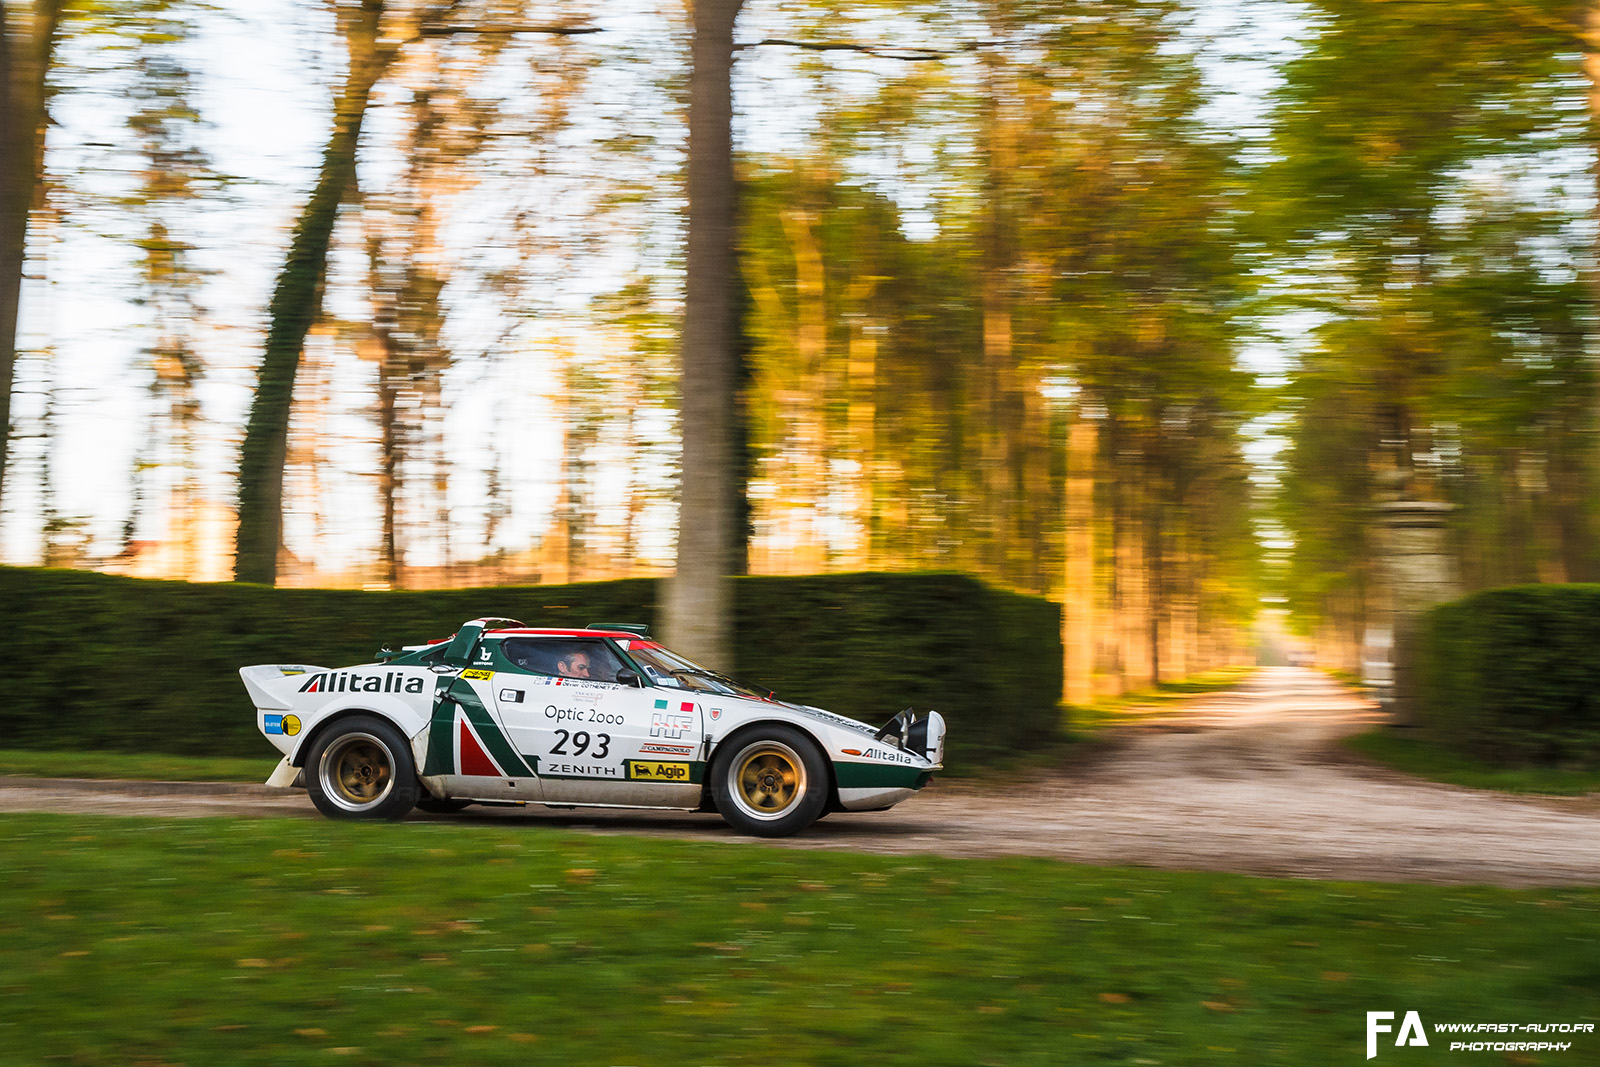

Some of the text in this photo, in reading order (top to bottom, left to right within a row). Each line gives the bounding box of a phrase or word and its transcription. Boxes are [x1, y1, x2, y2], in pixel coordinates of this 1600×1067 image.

[298, 671, 425, 694] Alitalia
[544, 705, 625, 725] Optic 2000
[649, 712, 693, 739] HF
[549, 728, 611, 759] 293
[647, 745, 691, 753] CAMPAGNOLO
[862, 747, 912, 764] Alitalia
[548, 763, 616, 776] ZENITH
[655, 764, 686, 779] Agip
